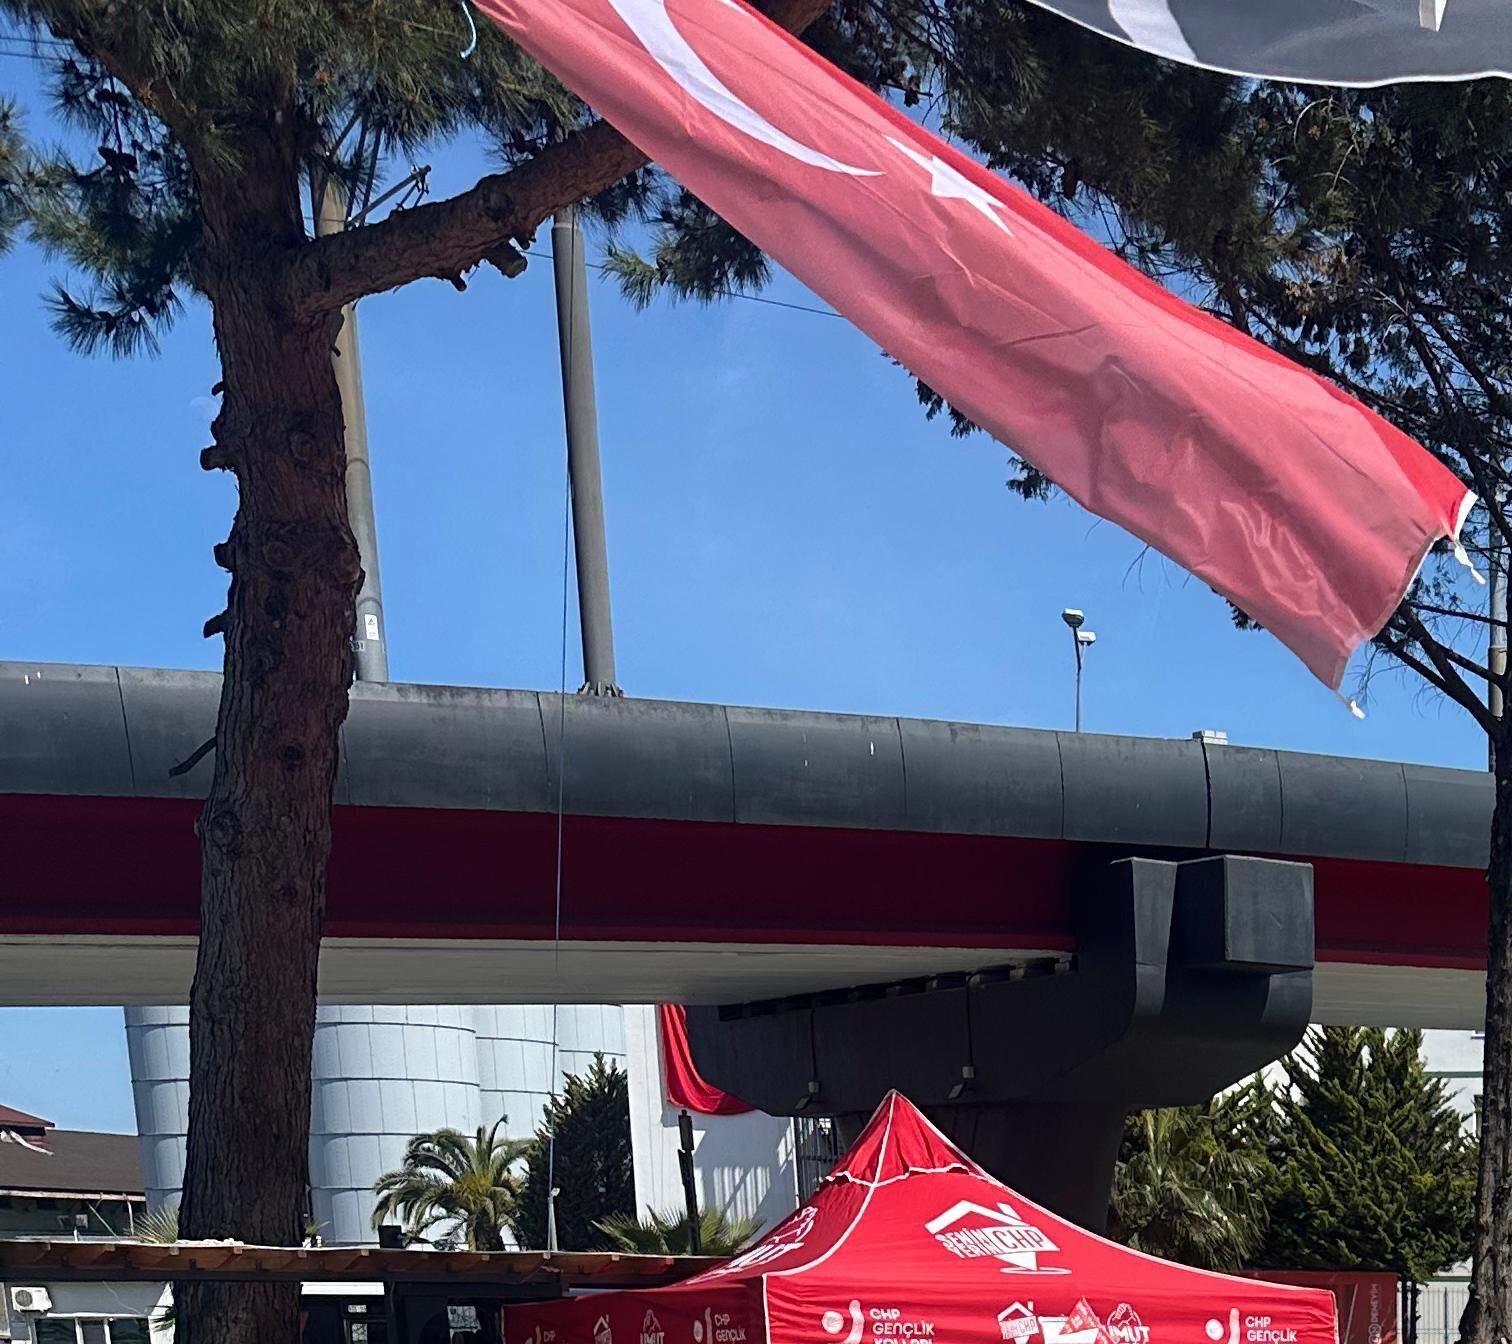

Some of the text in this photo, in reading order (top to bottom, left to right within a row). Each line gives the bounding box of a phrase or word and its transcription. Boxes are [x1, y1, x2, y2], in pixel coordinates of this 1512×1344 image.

[991, 1229, 1044, 1250] CHP
[714, 1314, 731, 1326] CHP
[869, 1308, 901, 1320] CHP
[1245, 1316, 1272, 1328] CHP
[872, 1320, 935, 1339] GENÇLİK
[1246, 1328, 1297, 1344] GENÇLİK
